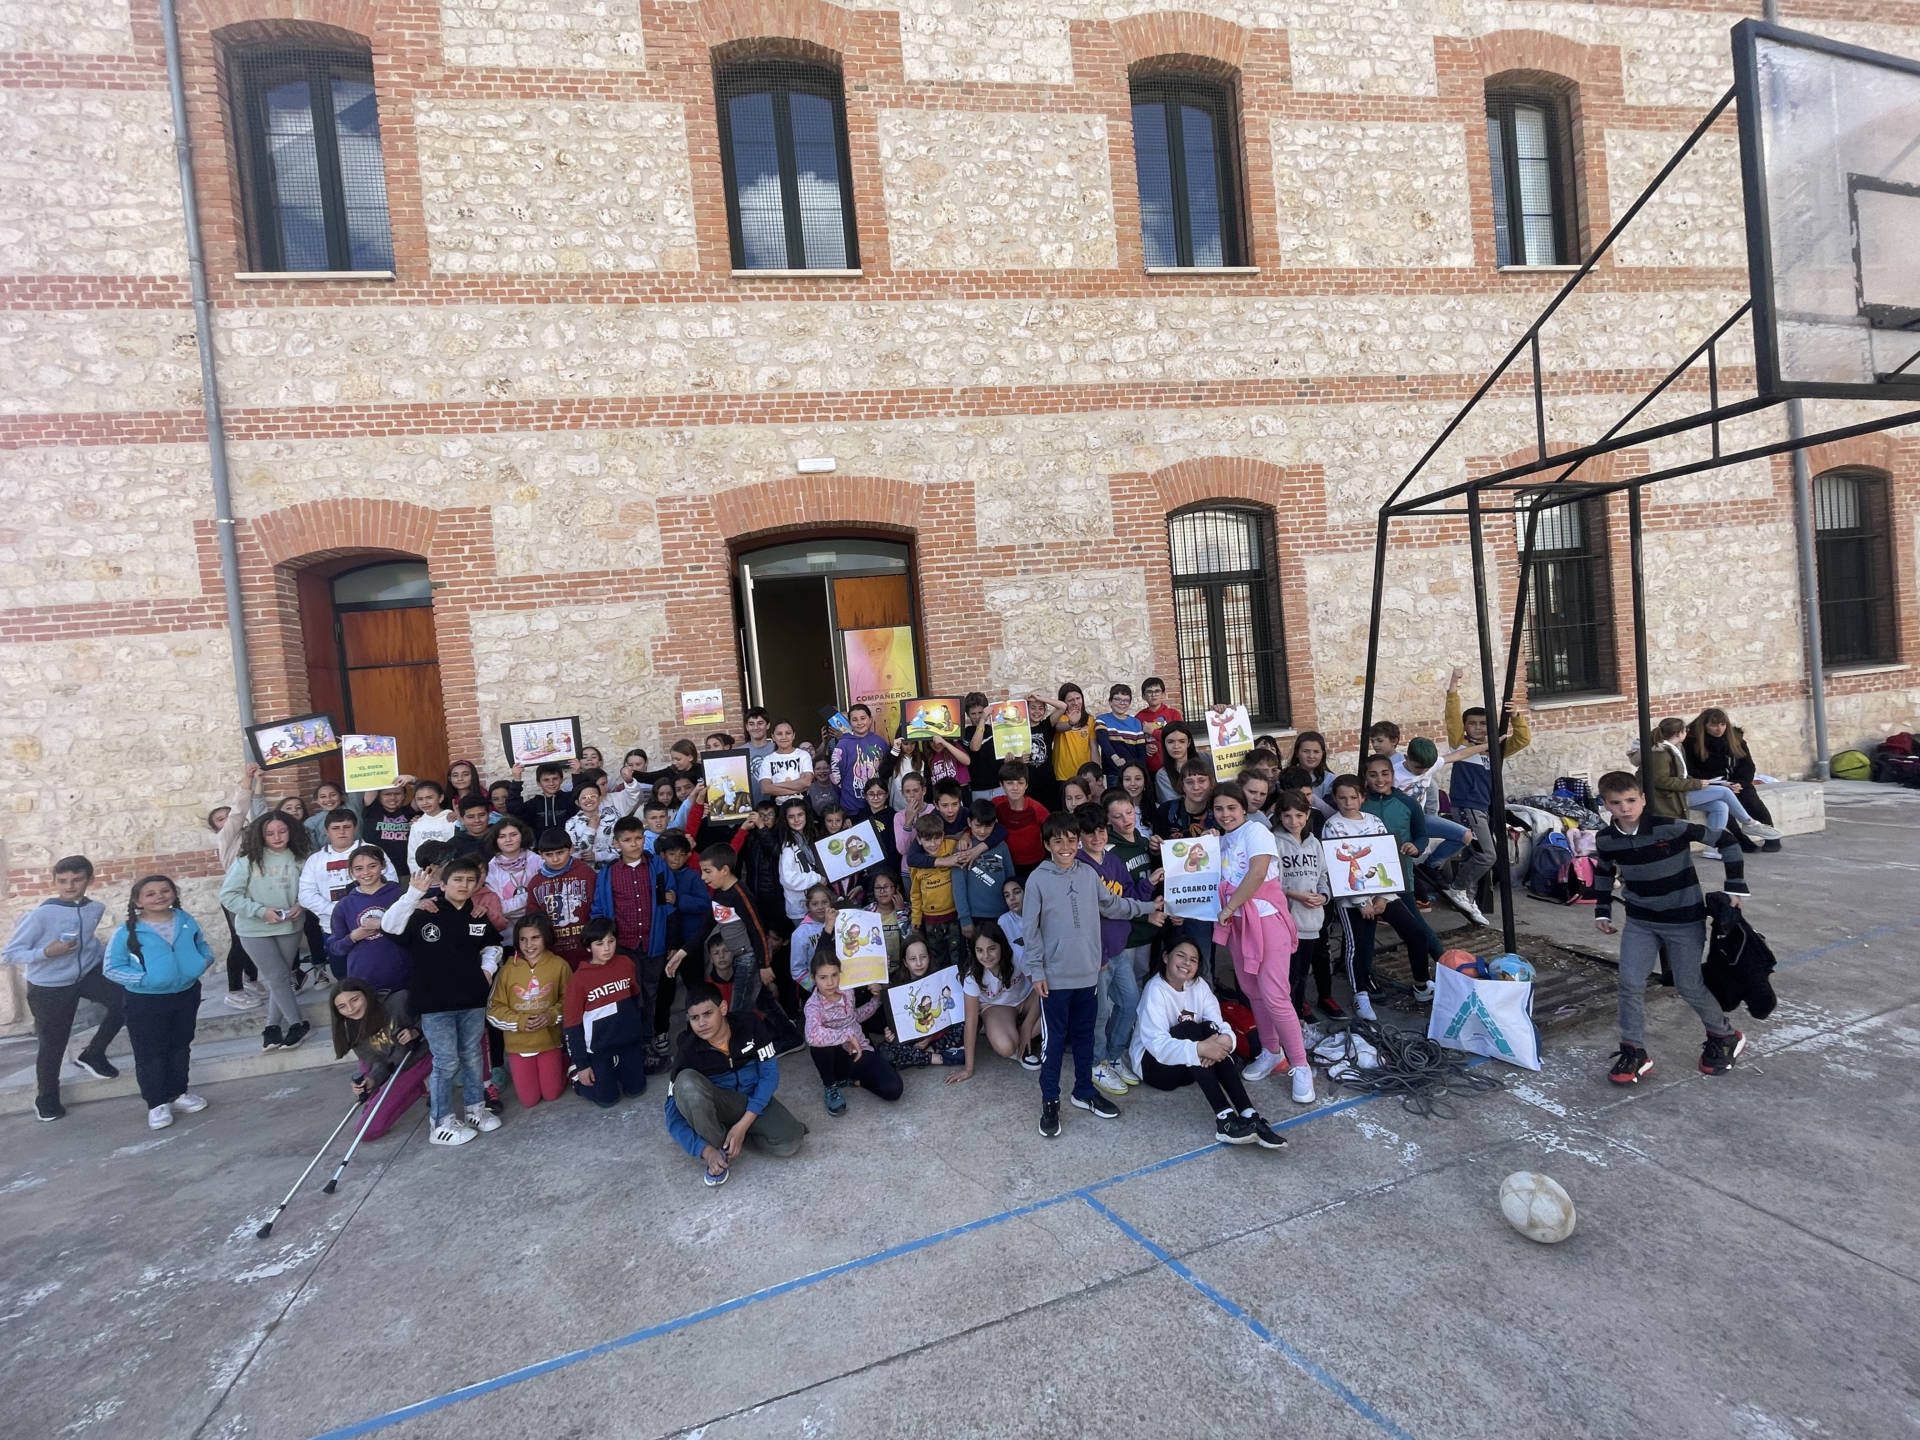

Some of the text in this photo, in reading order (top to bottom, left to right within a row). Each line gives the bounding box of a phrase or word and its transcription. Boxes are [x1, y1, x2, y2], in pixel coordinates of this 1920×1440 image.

[380, 830, 408, 840] ROCK
[1281, 853, 1318, 868] SKATE
[1182, 884, 1207, 893] GRANO
